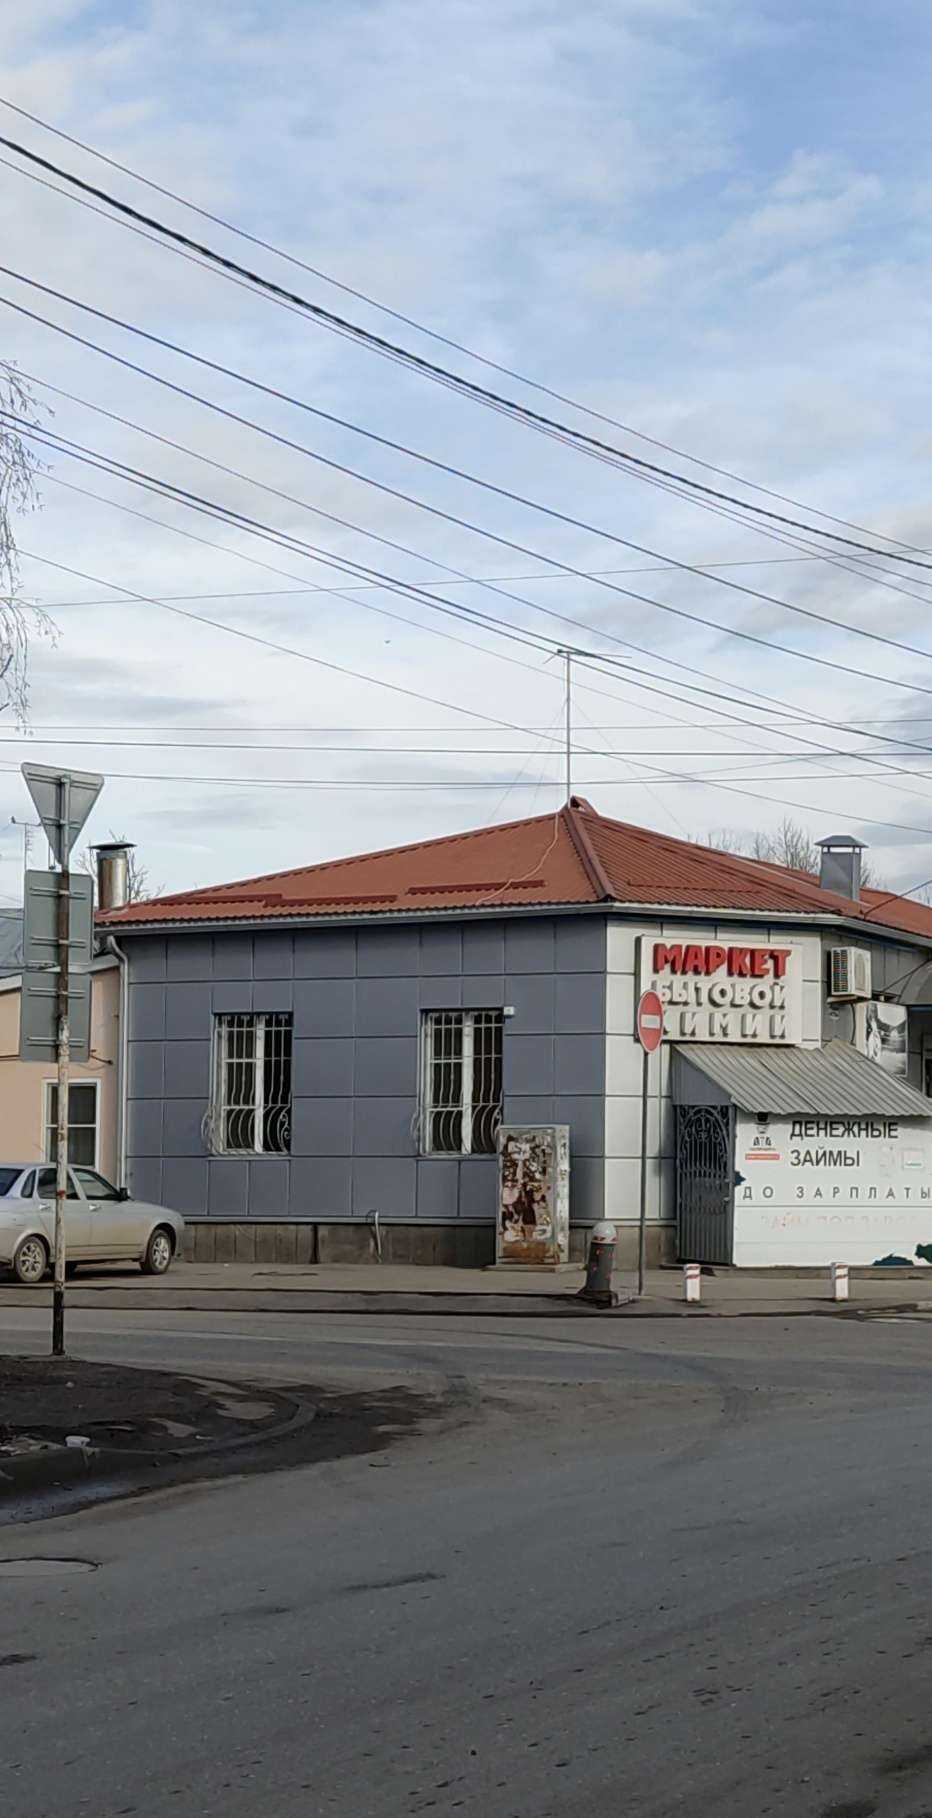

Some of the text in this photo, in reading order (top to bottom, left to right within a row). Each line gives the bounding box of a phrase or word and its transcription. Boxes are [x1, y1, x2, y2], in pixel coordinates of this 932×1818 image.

[653, 943, 791, 978] МАРКЕТ
[652, 979, 787, 1009] БЫТОВОЙ
[790, 1120, 899, 1140] ДЕНЕЖНЫЕ
[790, 1146, 860, 1167] ЗАЙМЫ
[743, 1186, 931, 1200] ДО ЗАРПЛАТЫ
